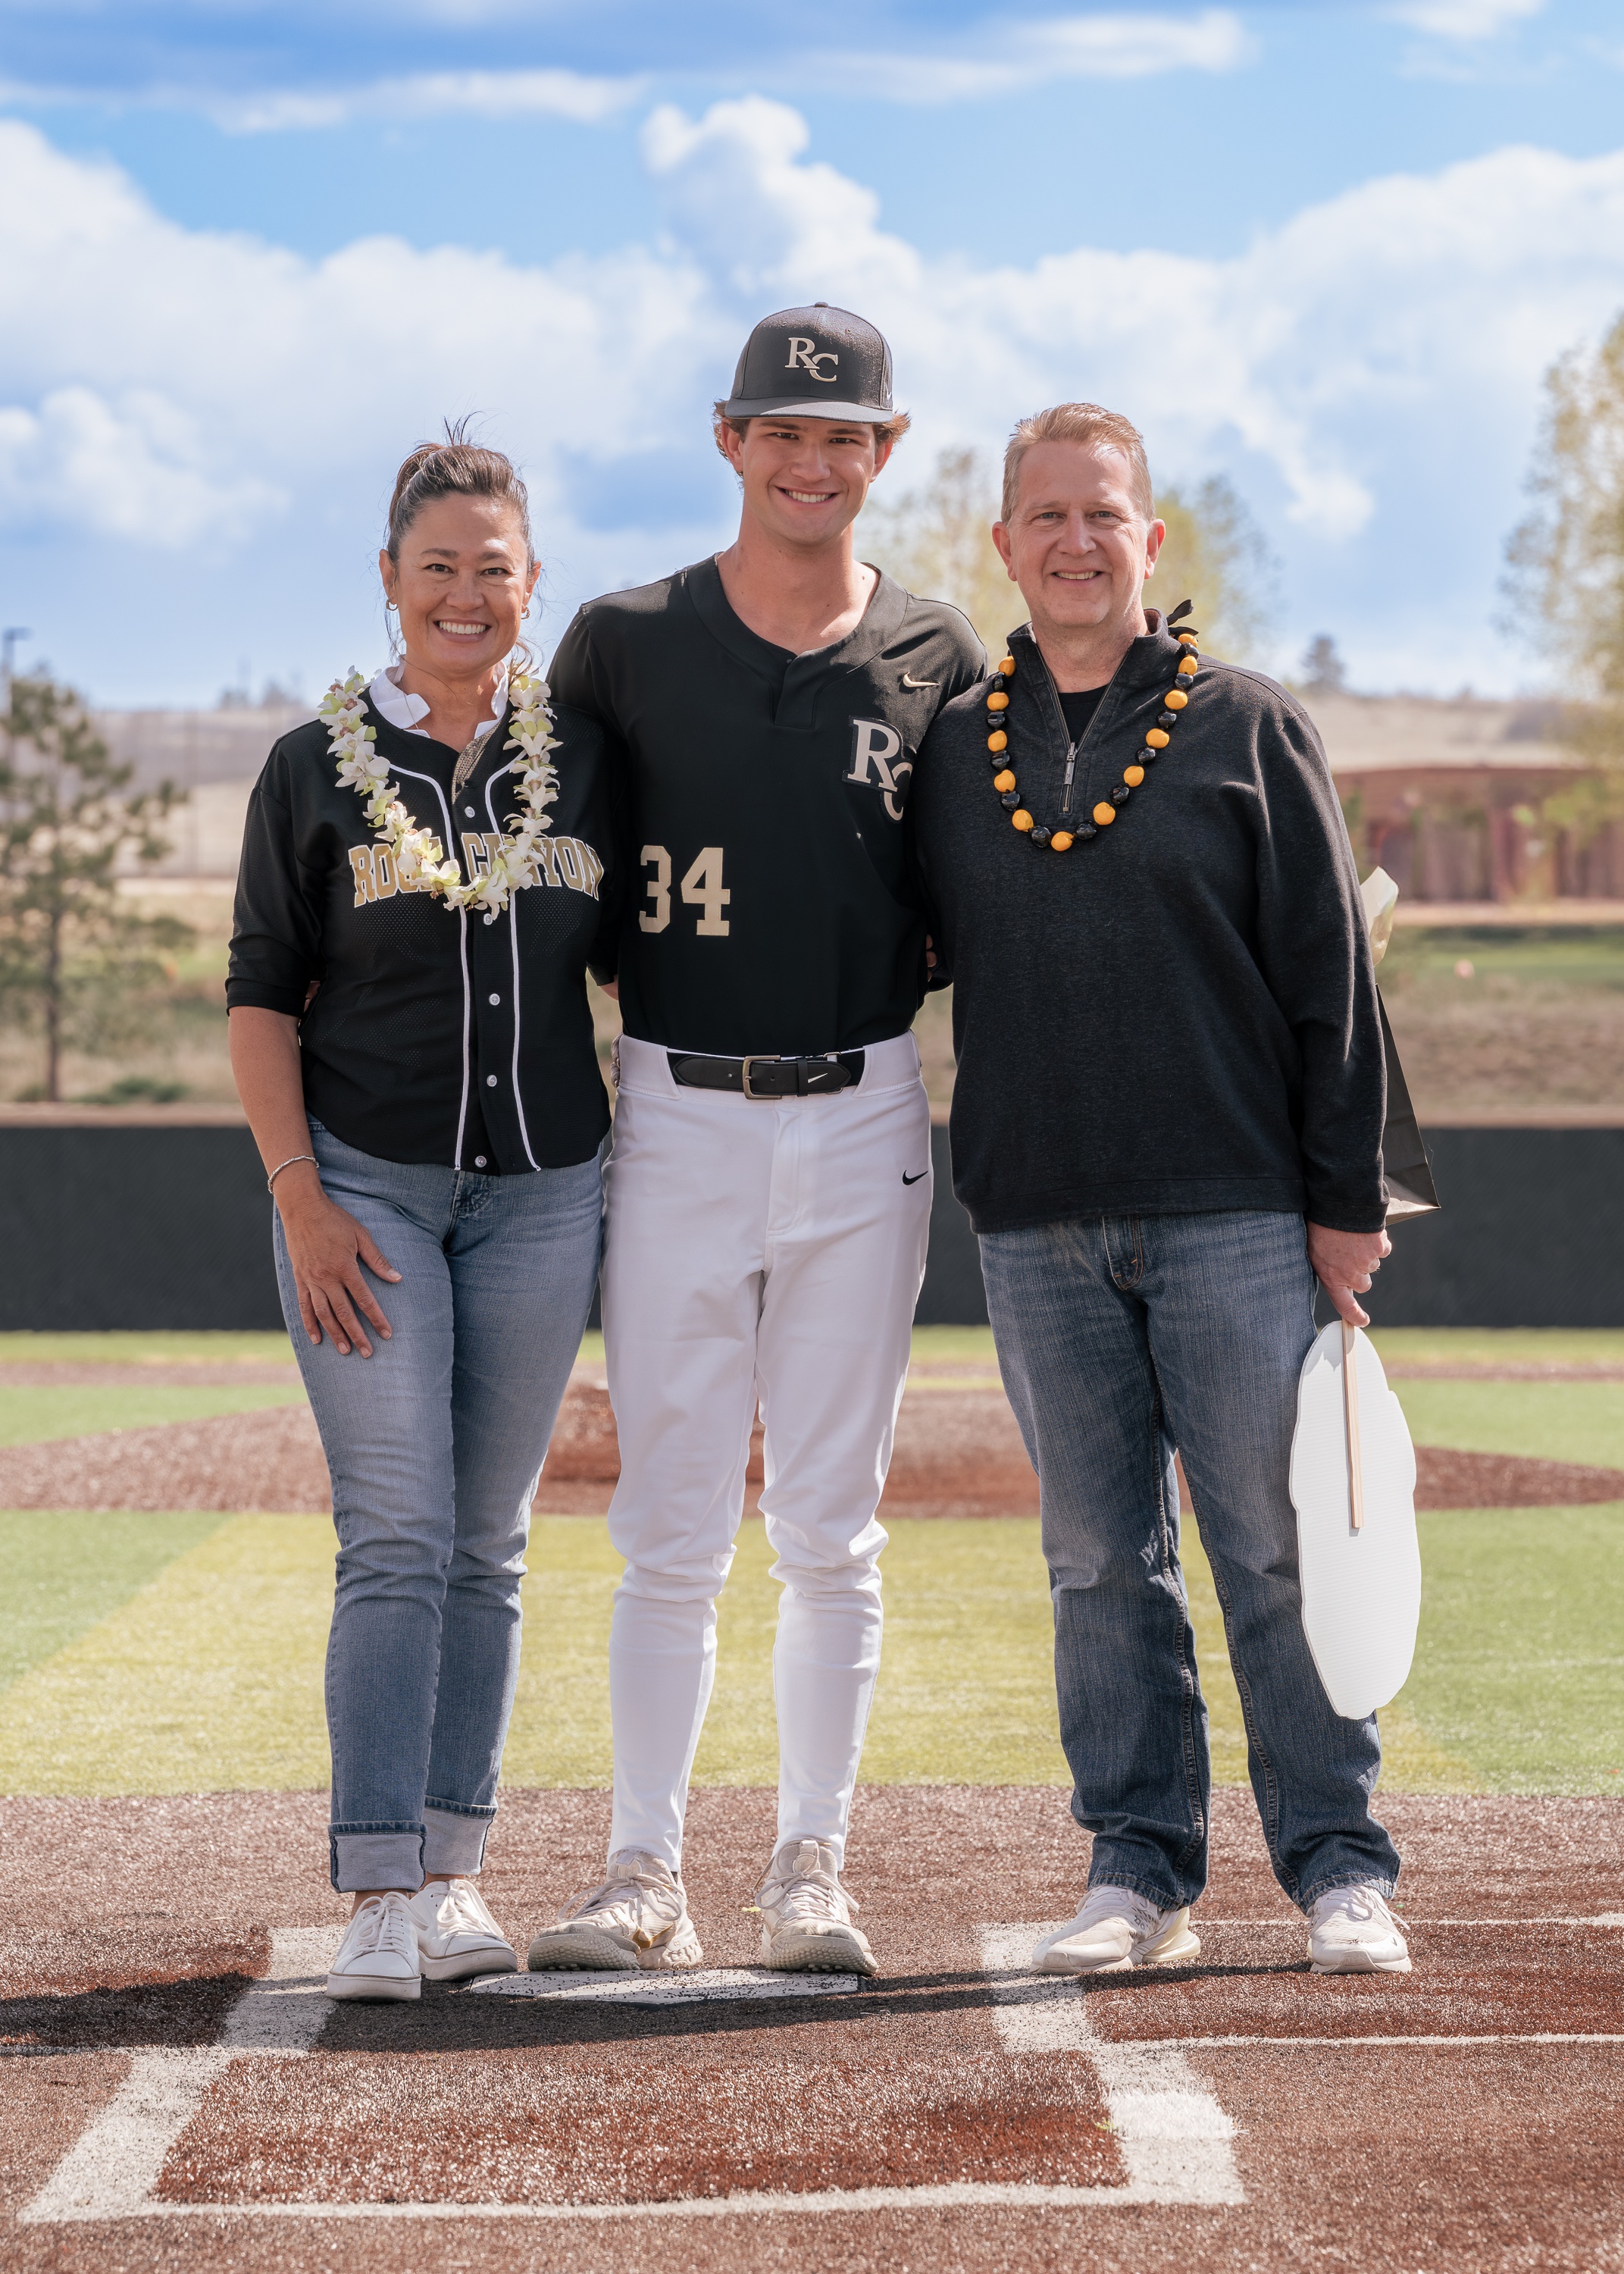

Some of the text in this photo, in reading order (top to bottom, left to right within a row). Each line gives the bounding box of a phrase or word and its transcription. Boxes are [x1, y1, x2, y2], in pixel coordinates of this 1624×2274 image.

[784, 337, 838, 382] RC
[846, 719, 913, 821] RC
[638, 844, 731, 937] 34
